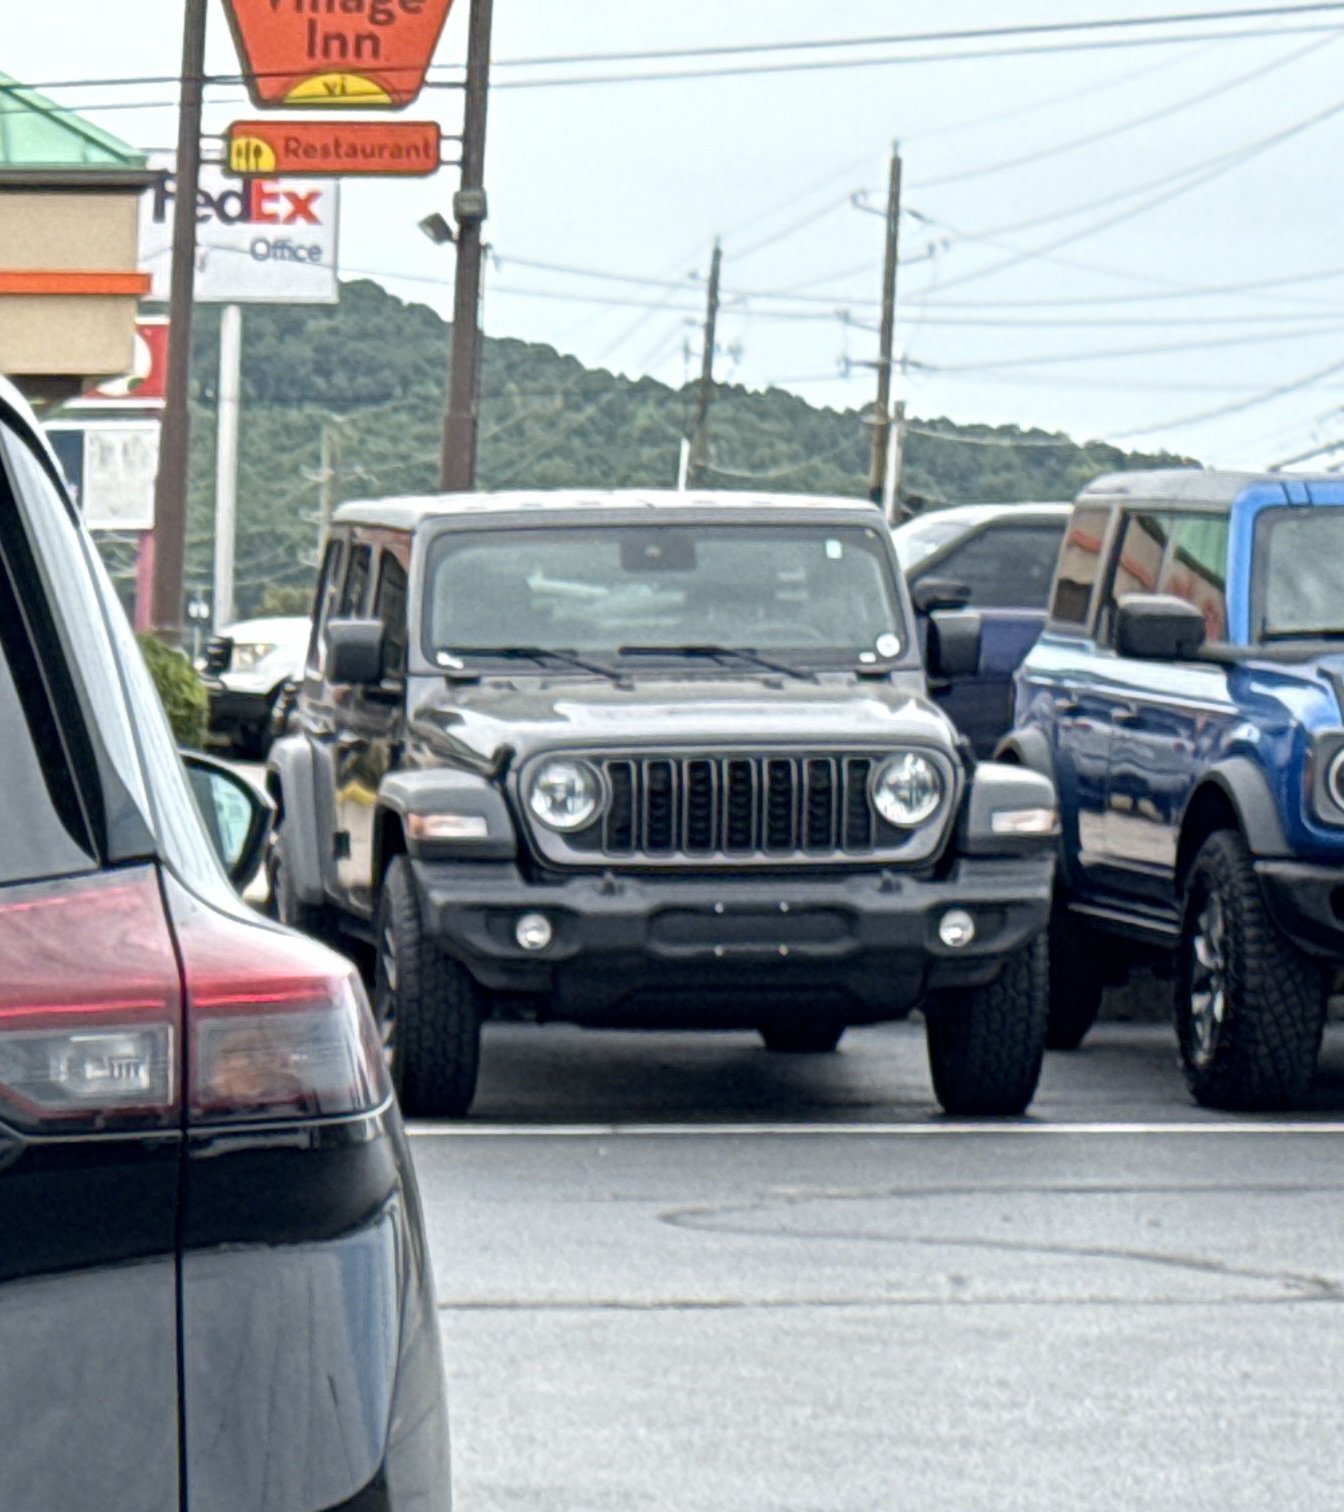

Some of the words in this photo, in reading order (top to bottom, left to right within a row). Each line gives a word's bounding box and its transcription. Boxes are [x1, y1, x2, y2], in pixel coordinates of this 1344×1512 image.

[307, 18, 381, 60] Inn
[283, 136, 433, 160] Restaurant
[249, 236, 323, 262] Office
